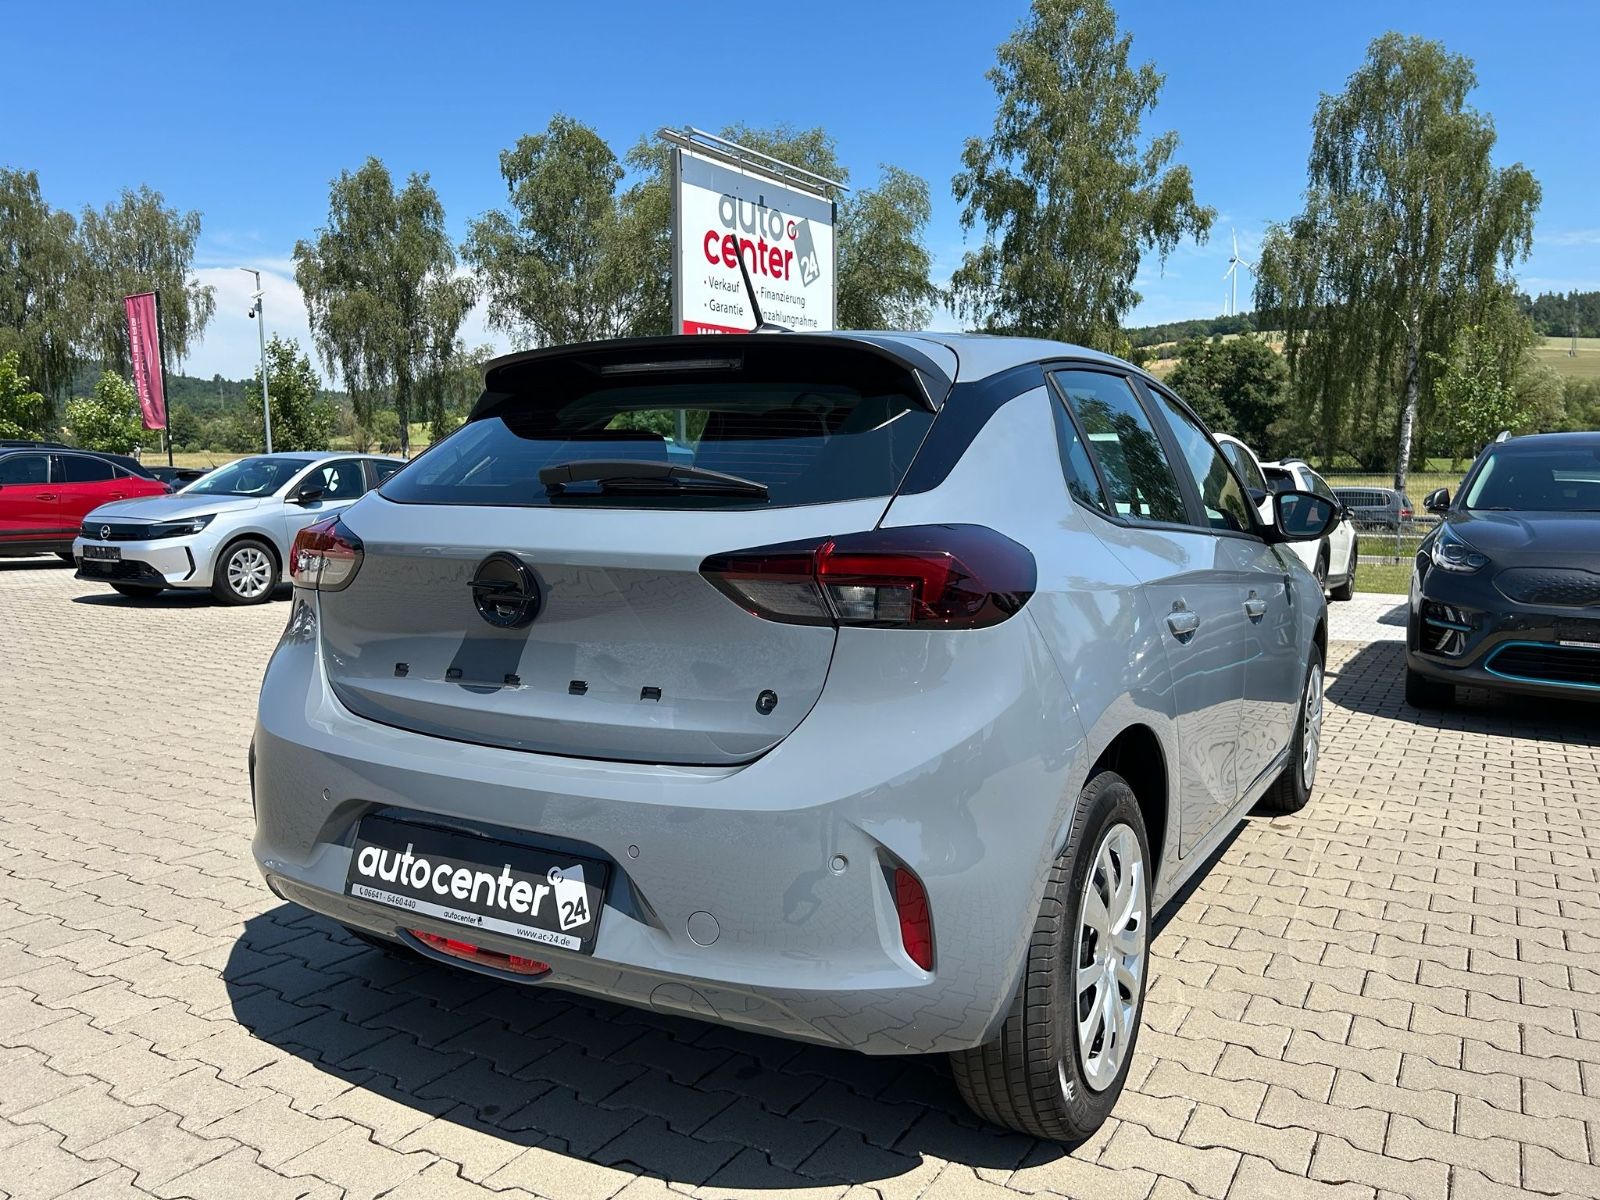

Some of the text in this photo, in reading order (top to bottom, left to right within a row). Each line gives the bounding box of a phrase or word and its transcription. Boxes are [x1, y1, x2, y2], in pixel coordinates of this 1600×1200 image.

[718, 194, 785, 241] auto
[704, 230, 793, 281] center
[800, 251, 818, 284] 24
[708, 276, 740, 293] Verkauf
[709, 299, 744, 316] Garantie
[760, 287, 806, 309] Finanzierung
[443, 910, 477, 924] autocenter
[561, 896, 588, 927] 24
[516, 927, 571, 946] www.ac-24.de
